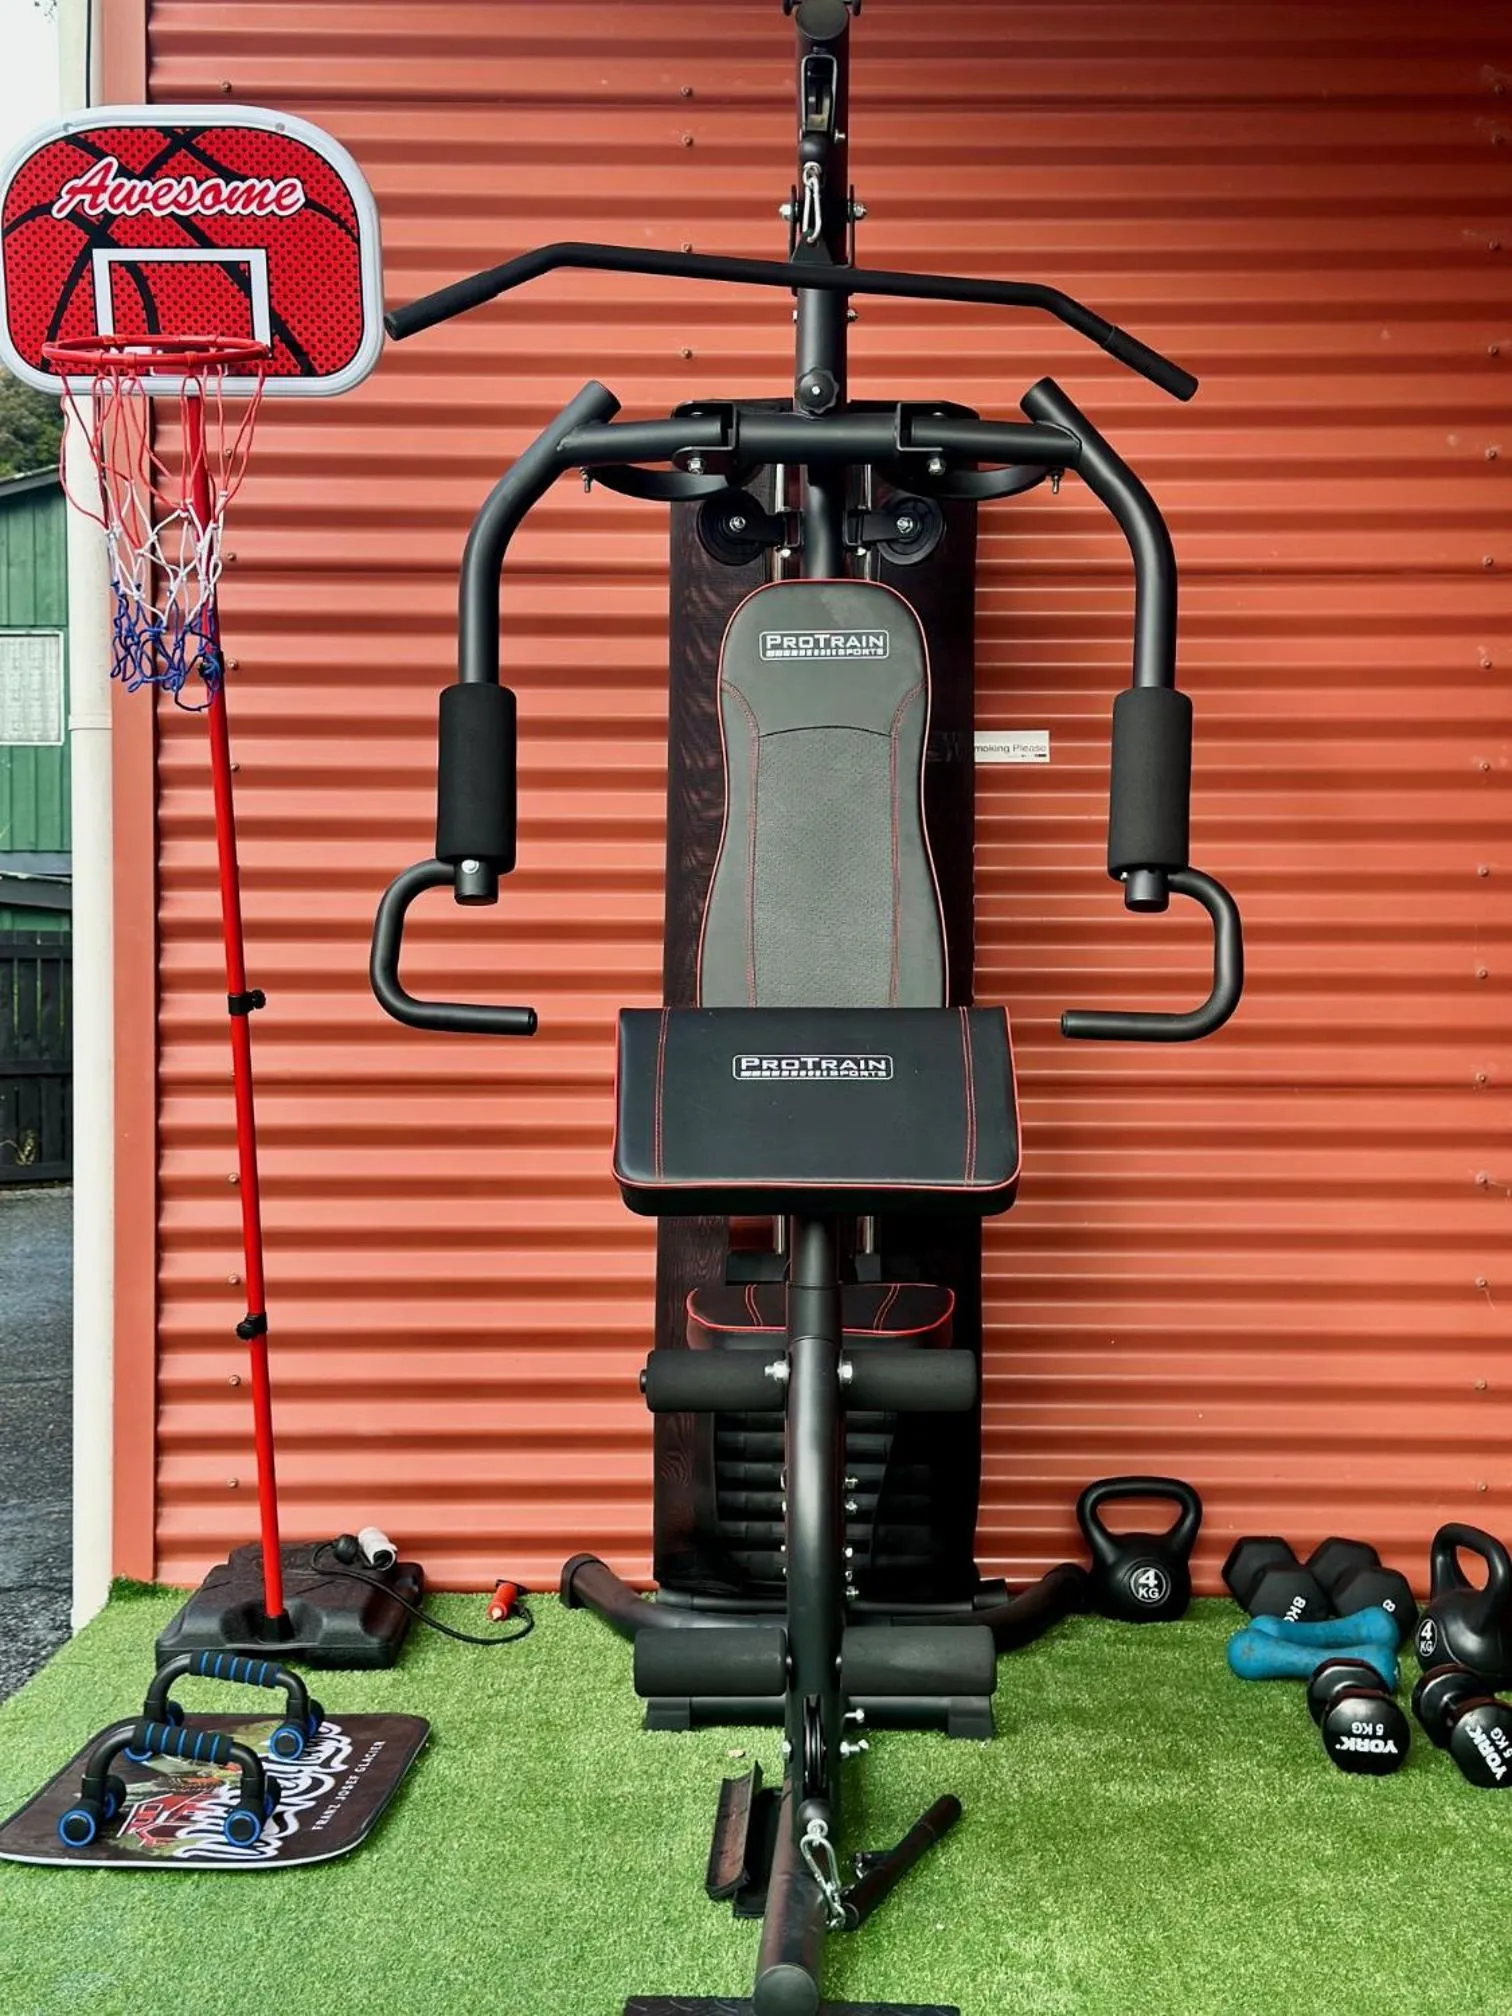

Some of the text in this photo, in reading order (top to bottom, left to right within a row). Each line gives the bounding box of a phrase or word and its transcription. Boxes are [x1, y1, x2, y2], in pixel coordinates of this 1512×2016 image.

[51, 155, 306, 219] Awesome
[837, 648, 885, 657] SPORTS
[974, 743, 1011, 754] moking
[829, 1069, 887, 1078] SPORTS
[1138, 1568, 1158, 1588] 4
[1138, 1586, 1160, 1599] KG
[1420, 1620, 1433, 1641] 4
[1420, 1639, 1434, 1652] KG
[1351, 1721, 1385, 1736] 5 KG
[1337, 1736, 1399, 1754] YORK
[1490, 1726, 1509, 1750] KG
[1465, 1725, 1507, 1781] YORK
[311, 1740, 387, 1831] FRANZ JOSEF GLACIER
